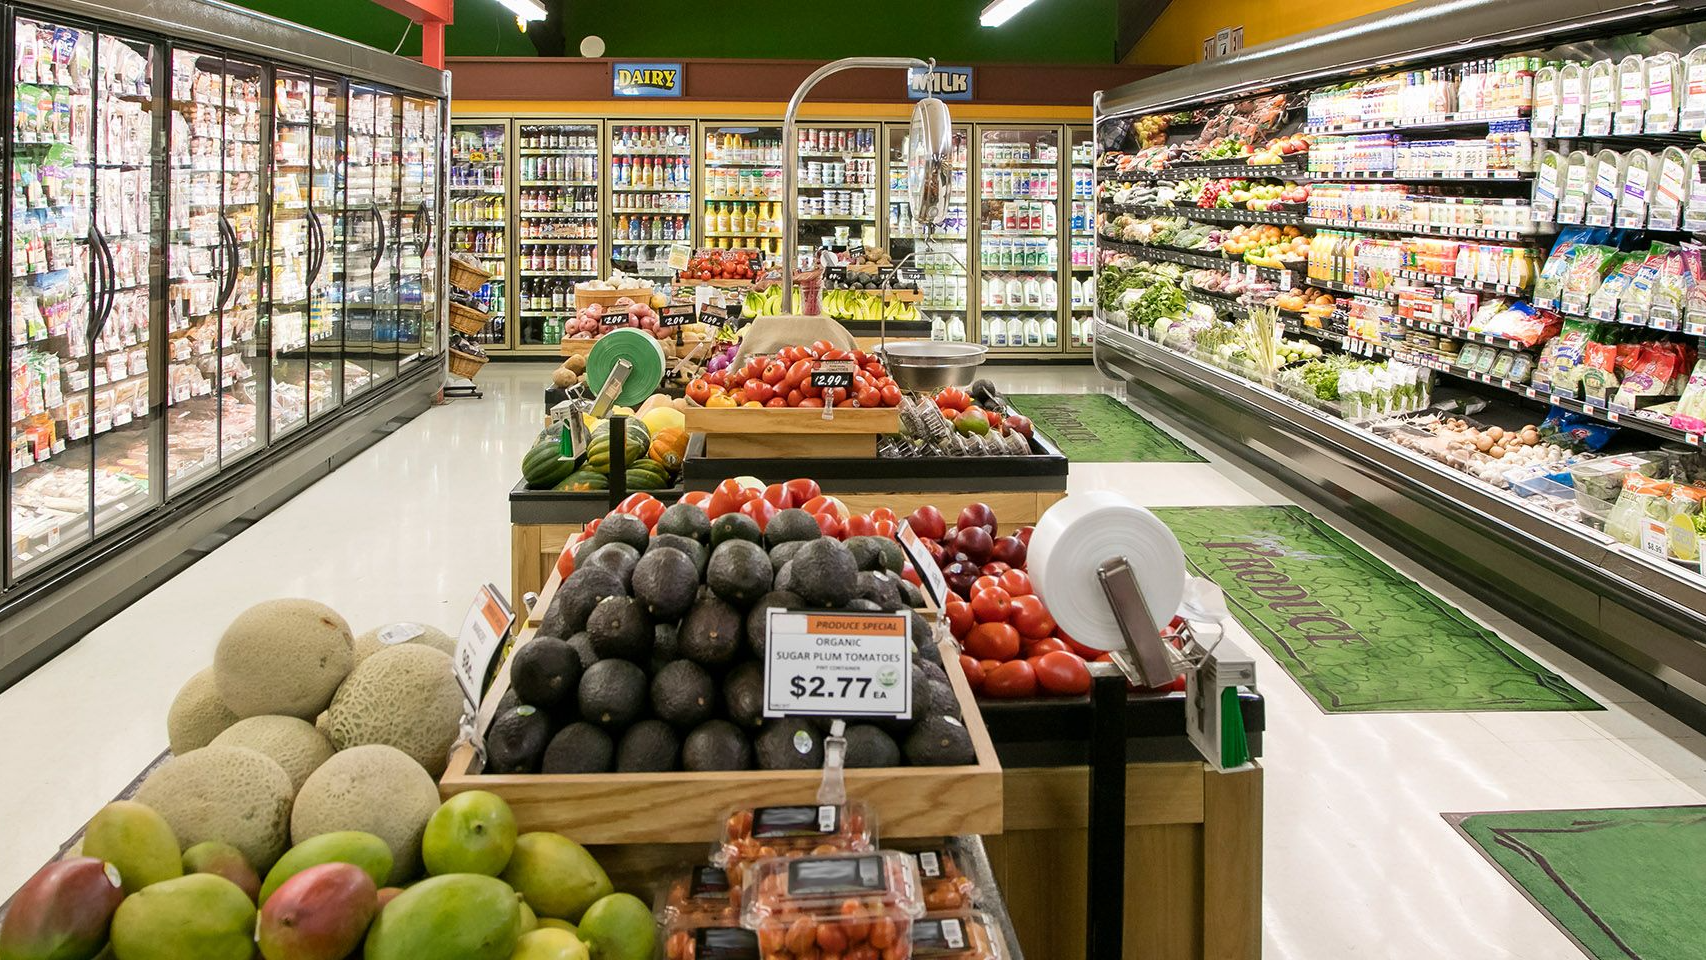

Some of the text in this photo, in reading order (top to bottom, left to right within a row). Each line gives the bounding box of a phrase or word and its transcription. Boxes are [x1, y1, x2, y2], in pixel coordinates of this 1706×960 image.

[618, 69, 677, 89] DAIRY
[911, 72, 968, 93] MILK
[814, 375, 842, 386] $2.99
[1203, 542, 1373, 648] PRODUCE
[816, 621, 898, 631] PRODUCE SPECIAL
[815, 637, 862, 647] ORGANIC
[776, 651, 901, 662] SUGAR PLUM TOMATOES
[790, 675, 887, 699] $2.77 EA
